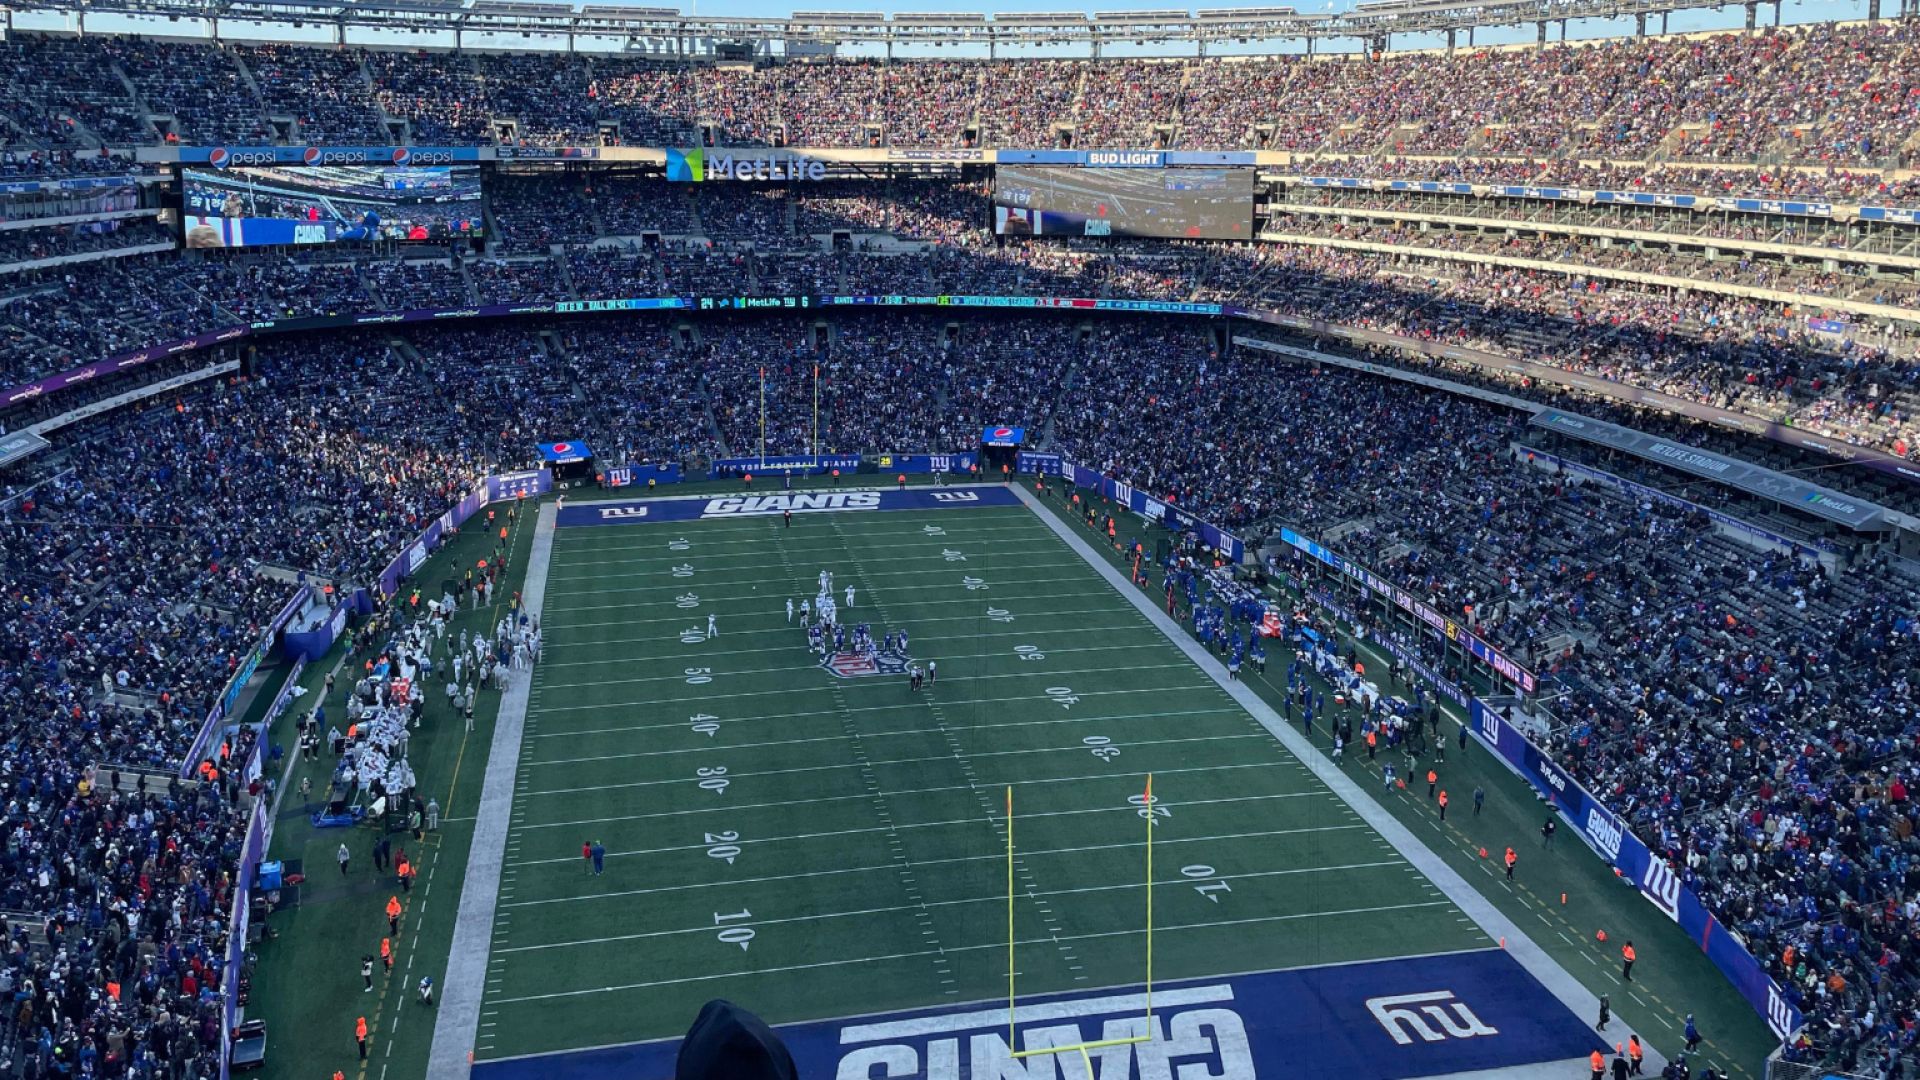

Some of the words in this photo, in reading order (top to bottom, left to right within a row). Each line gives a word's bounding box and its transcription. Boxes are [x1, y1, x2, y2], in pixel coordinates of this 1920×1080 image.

[231, 150, 276, 166] pepsi
[323, 150, 367, 165] pepsi
[412, 150, 454, 165] pepsi
[708, 153, 826, 181] MetLife
[1090, 153, 1118, 164] BUD
[1119, 153, 1160, 165] LIGHT
[294, 225, 326, 243] GIANTS
[700, 297, 713, 309] 24
[747, 297, 781, 307] MetLife
[801, 296, 809, 308] 6
[740, 463, 766, 471] YORK
[1648, 442, 1688, 461] METLIFE
[1685, 452, 1731, 473] STADIUM
[702, 491, 881, 516] GIANTS
[1820, 496, 1856, 515] MetLife
[1013, 645, 1046, 661] 50
[684, 667, 713, 684] 50
[1493, 653, 1520, 685] GIANTS
[1045, 686, 1080, 707] 40
[689, 713, 720, 732] 40
[1082, 736, 1121, 759] 30
[696, 766, 730, 790] 30
[1127, 794, 1172, 820] 20
[1586, 808, 1622, 857] GIANTS
[704, 831, 741, 860] 20
[1180, 864, 1232, 895] 10
[714, 908, 756, 945] 10
